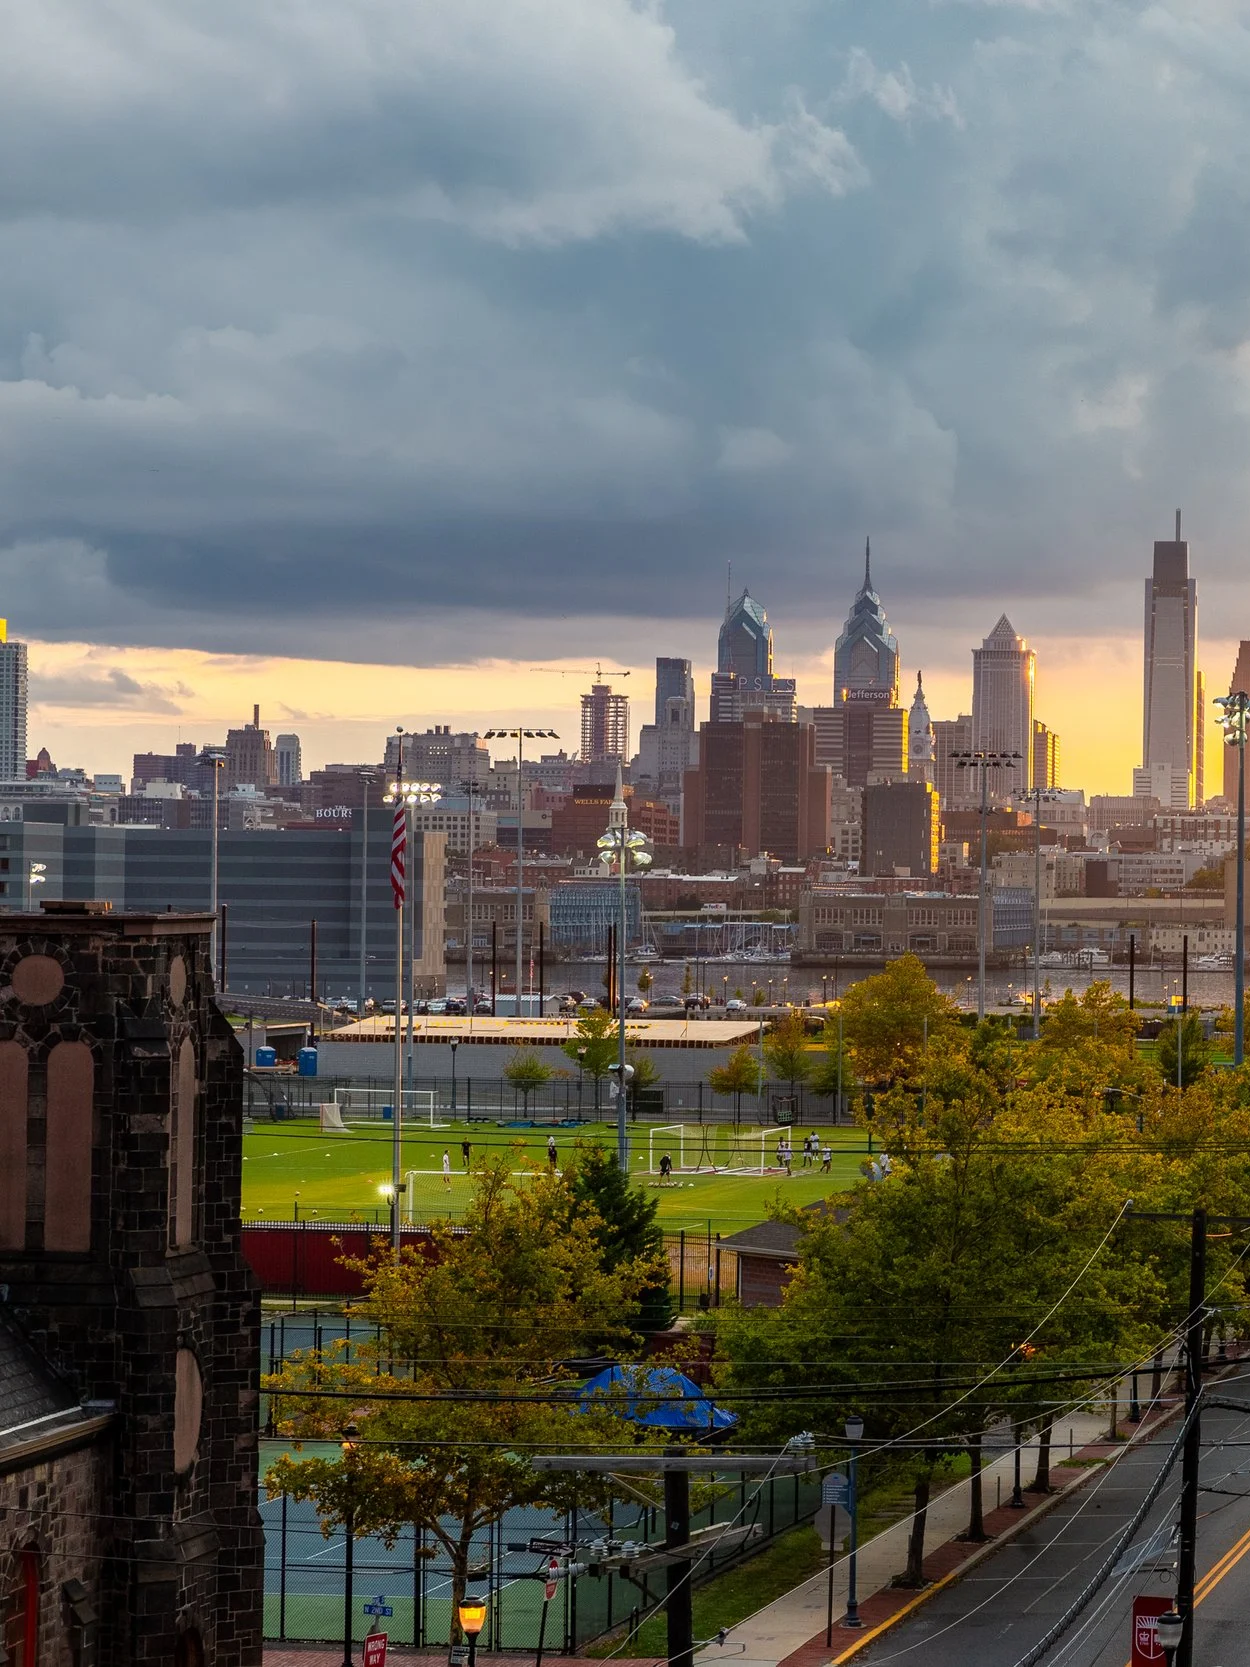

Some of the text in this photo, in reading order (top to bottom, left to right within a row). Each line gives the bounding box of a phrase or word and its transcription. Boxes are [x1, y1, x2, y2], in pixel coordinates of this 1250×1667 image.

[847, 689, 890, 699] Jefferson
[364, 1605, 392, 1616] N 2ND ST
[368, 1639, 385, 1652] WRONG
[369, 1653, 380, 1665] WAY
